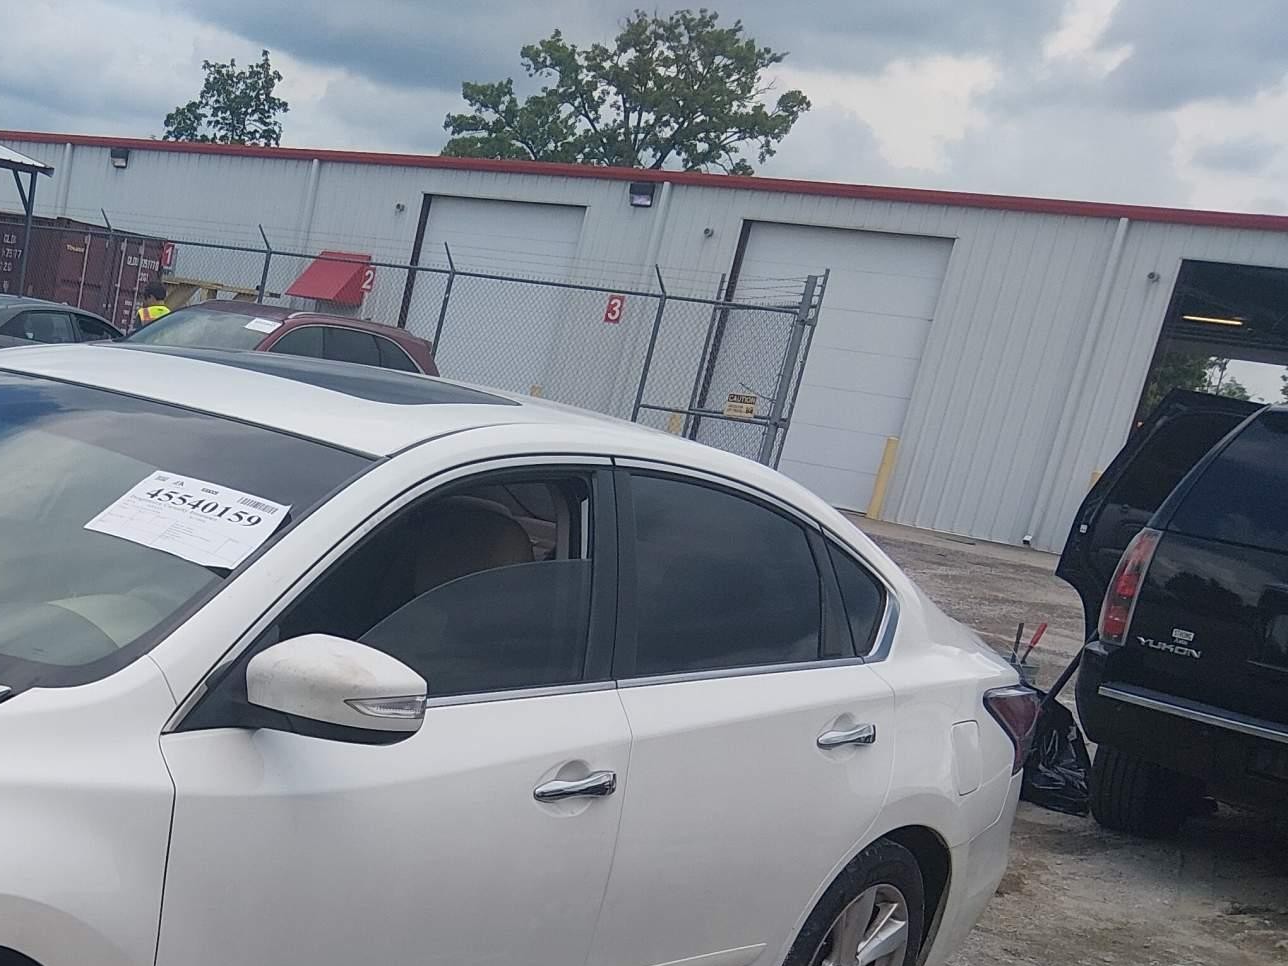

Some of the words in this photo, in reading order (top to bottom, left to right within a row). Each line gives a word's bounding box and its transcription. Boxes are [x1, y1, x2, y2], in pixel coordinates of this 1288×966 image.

[165, 246, 173, 265] 1
[361, 270, 374, 289] 2
[607, 298, 621, 320] 3
[728, 394, 757, 404] CAUTION
[146, 487, 262, 528] 45540159
[1137, 635, 1201, 658] YUKON
